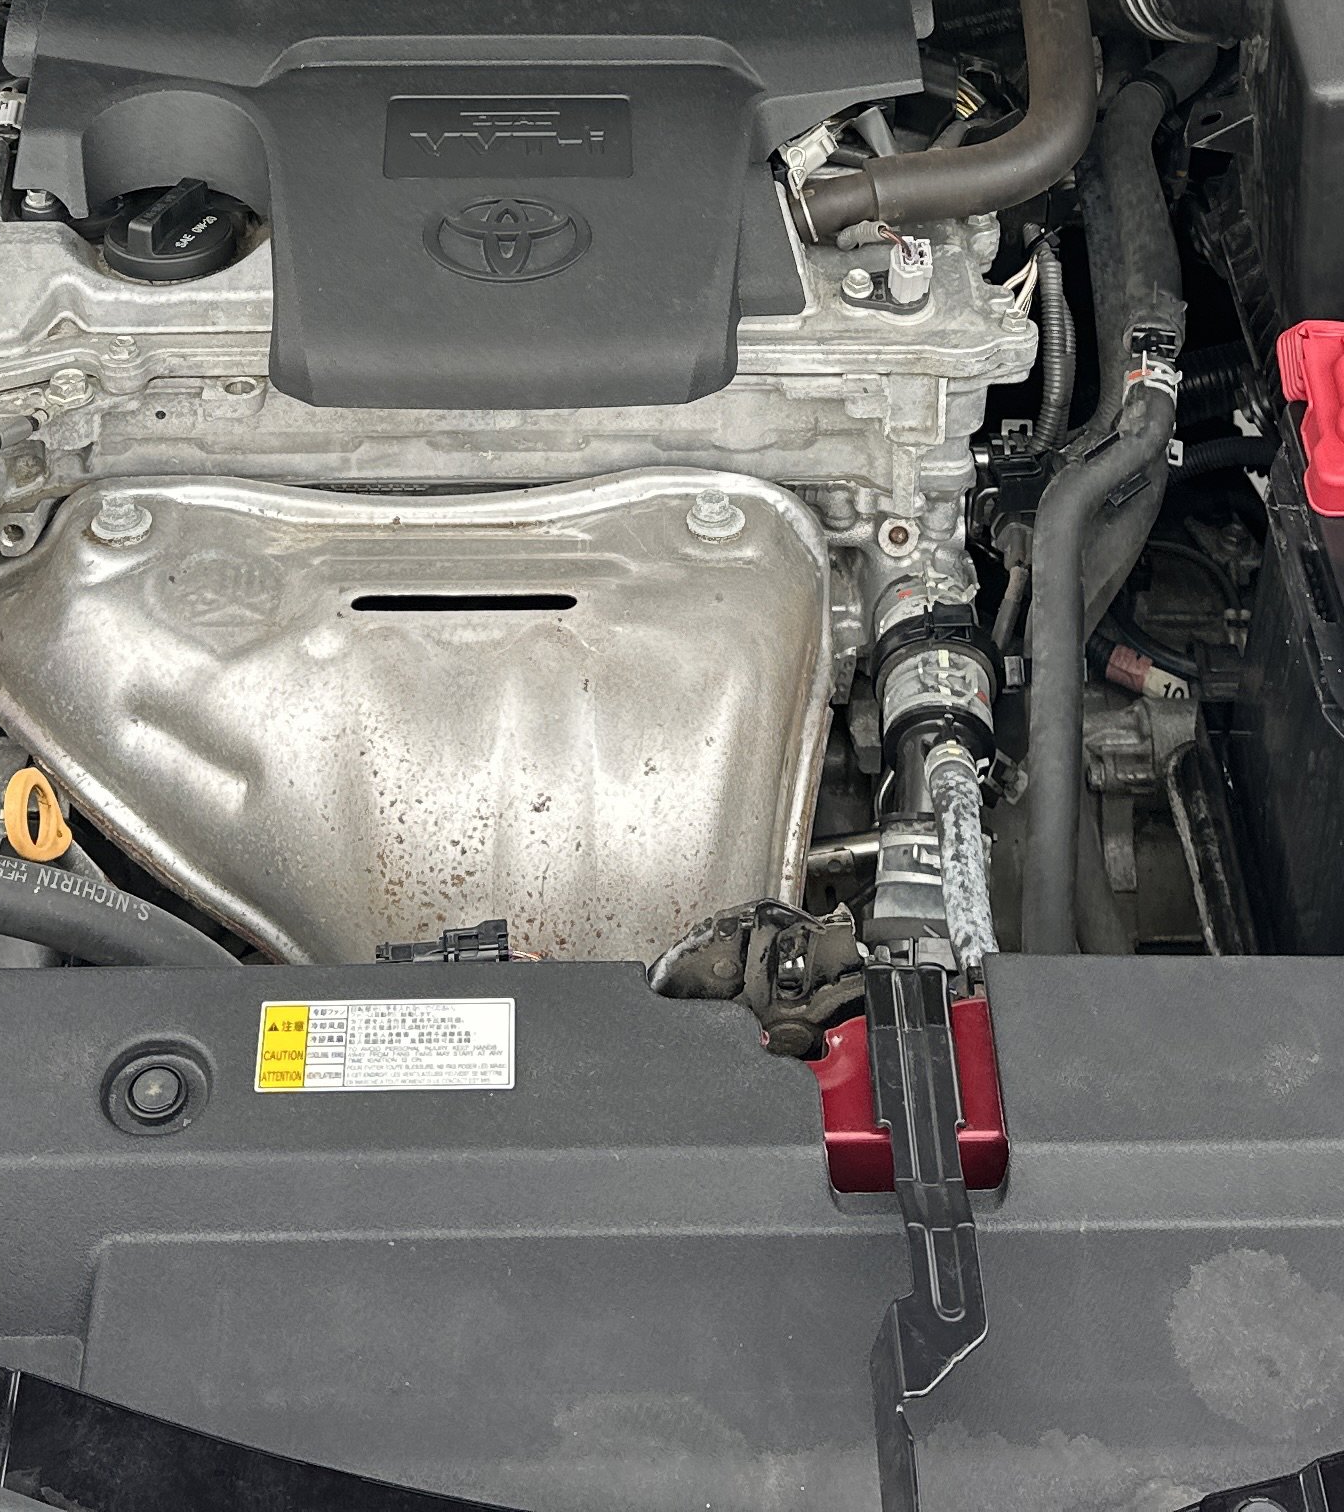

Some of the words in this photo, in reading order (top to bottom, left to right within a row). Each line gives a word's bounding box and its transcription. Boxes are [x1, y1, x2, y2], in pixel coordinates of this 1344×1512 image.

[175, 233, 196, 248] SAE
[281, 1020, 305, 1032] 注意
[263, 1050, 304, 1061] CAUTION
[261, 1071, 302, 1081] ATTENTION
